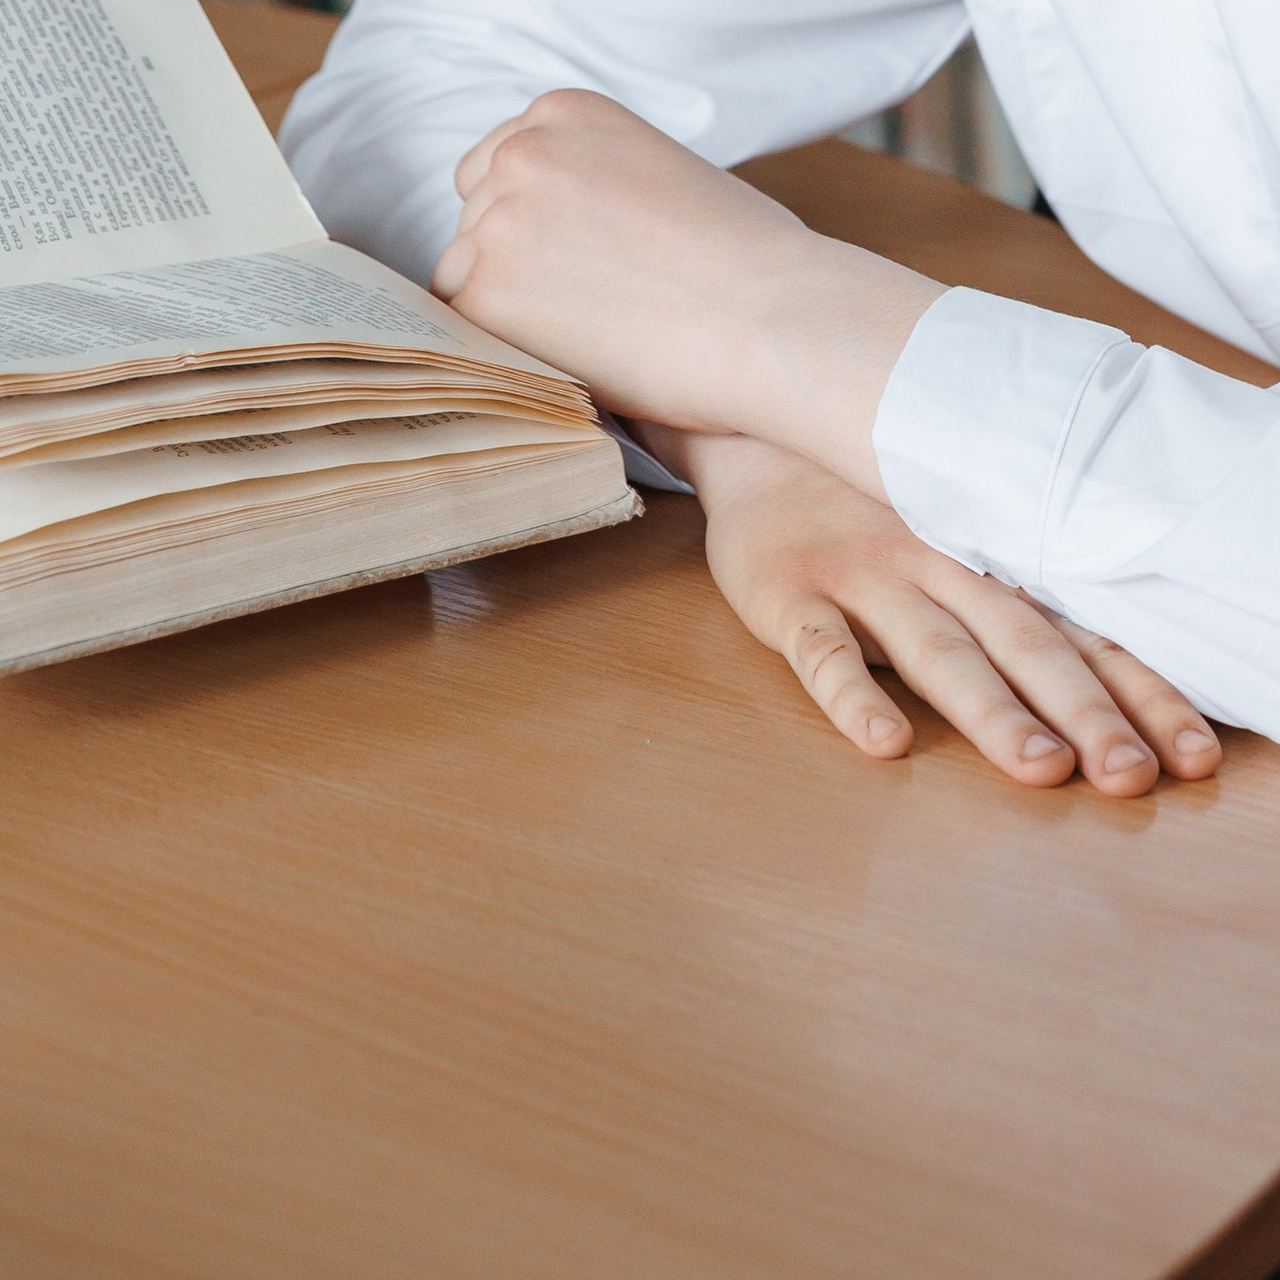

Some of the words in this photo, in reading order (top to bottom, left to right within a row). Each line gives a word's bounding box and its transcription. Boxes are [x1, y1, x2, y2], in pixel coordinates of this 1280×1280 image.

[6, 223, 24, 251] стол
[31, 220, 48, 245] Как
[44, 221, 61, 243] Вот
